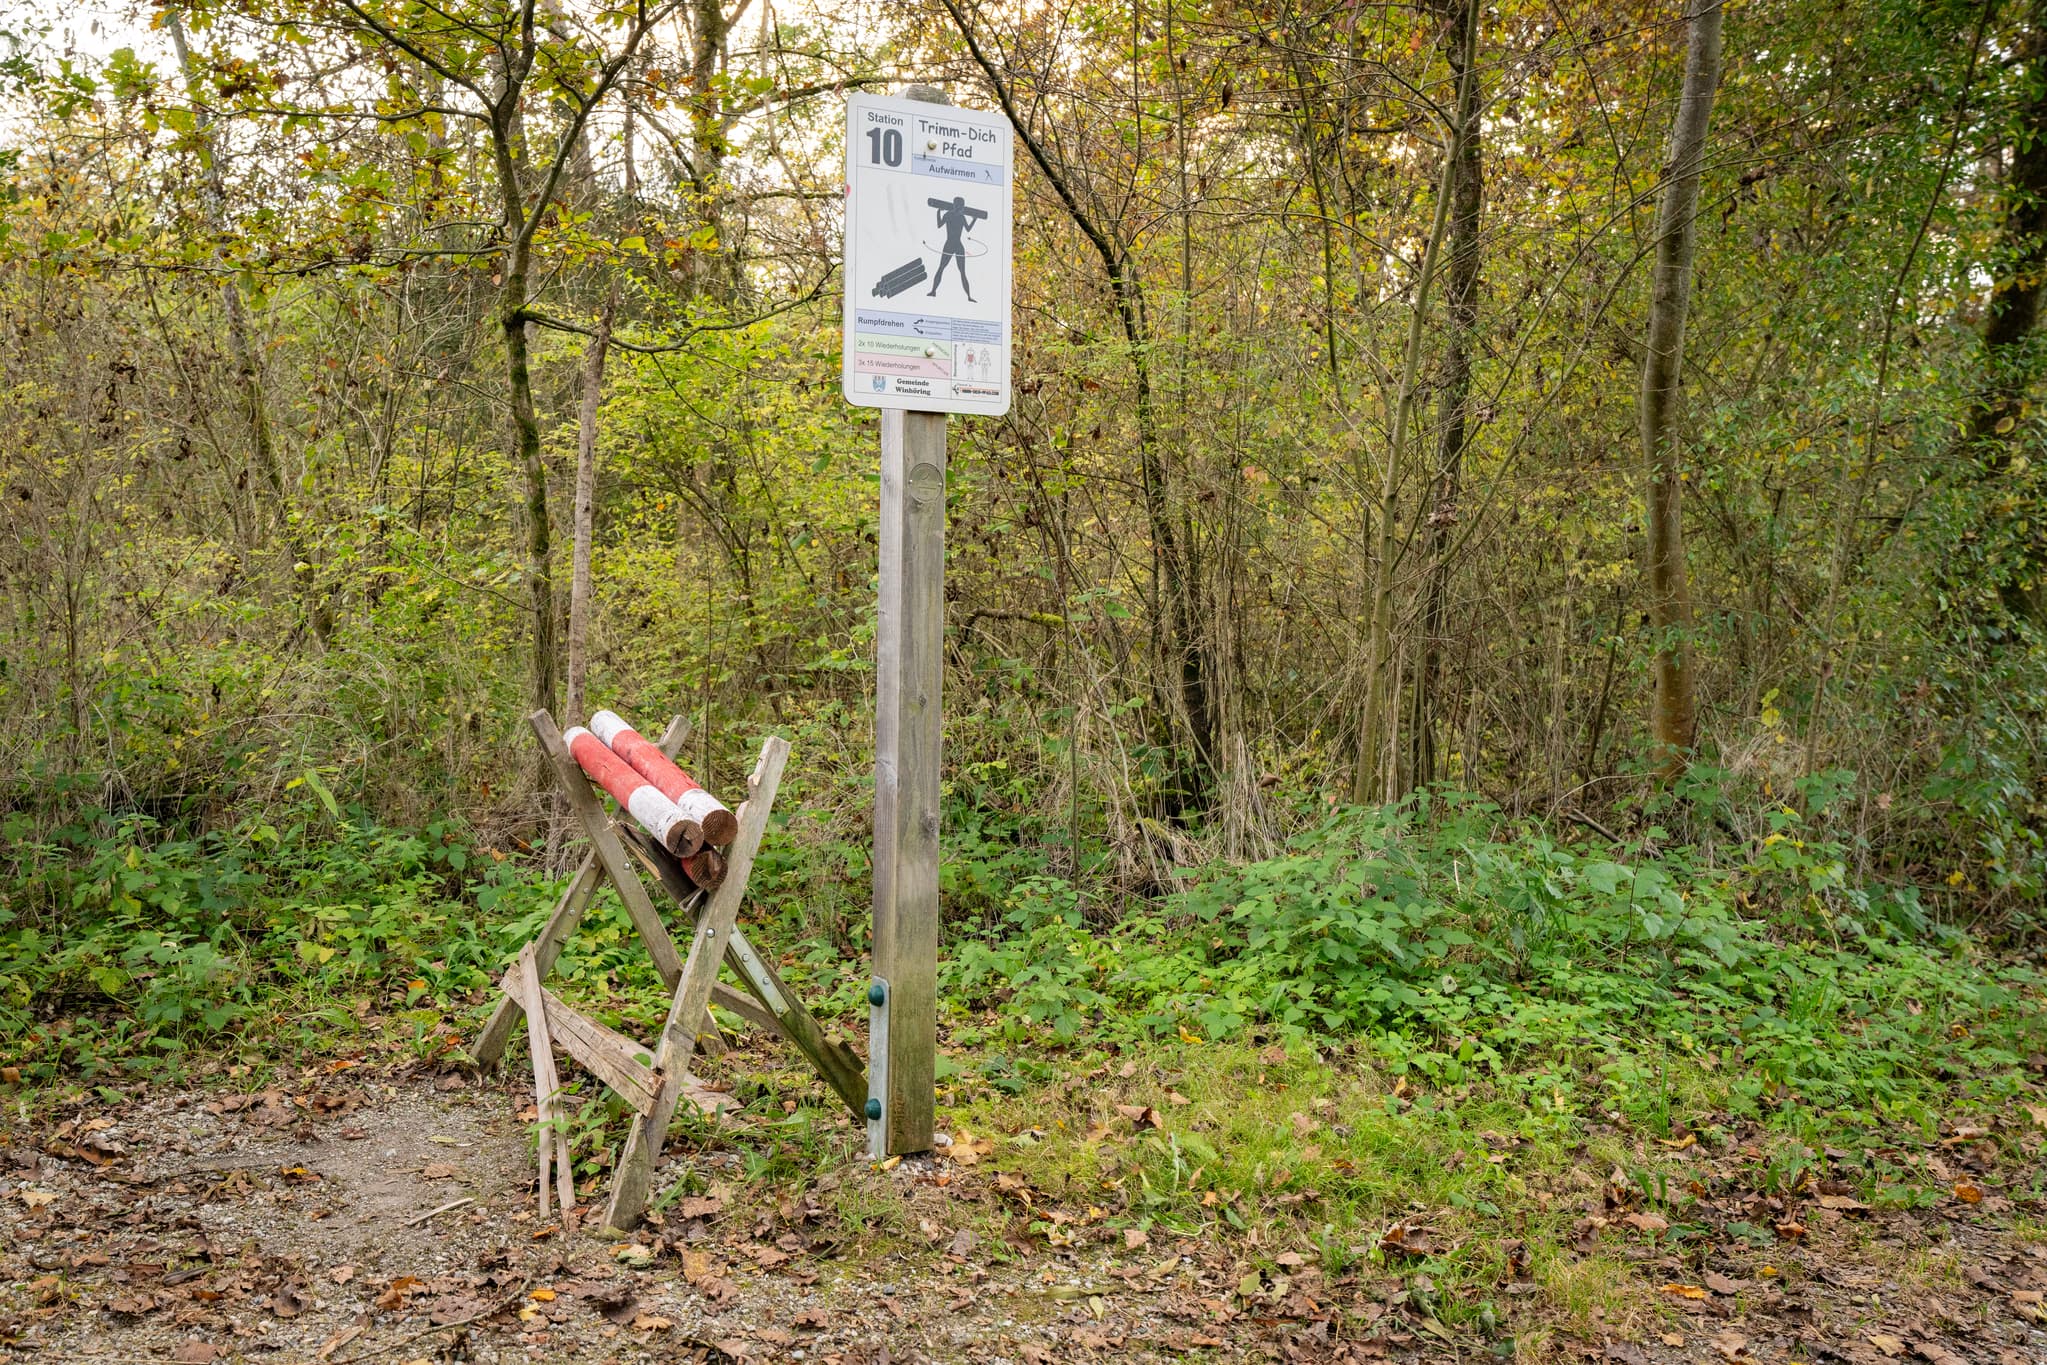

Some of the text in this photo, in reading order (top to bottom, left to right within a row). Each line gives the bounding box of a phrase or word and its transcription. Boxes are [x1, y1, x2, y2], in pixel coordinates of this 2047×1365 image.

[867, 111, 904, 126] Station
[918, 119, 997, 144] Trimm-Dich
[866, 126, 903, 168] 10
[942, 141, 973, 158] Pfad
[928, 164, 976, 178] Aufwärmen
[857, 316, 905, 329] Rumpfdrehen
[896, 377, 930, 387] Gemeinde
[895, 386, 931, 396] Winhöring
